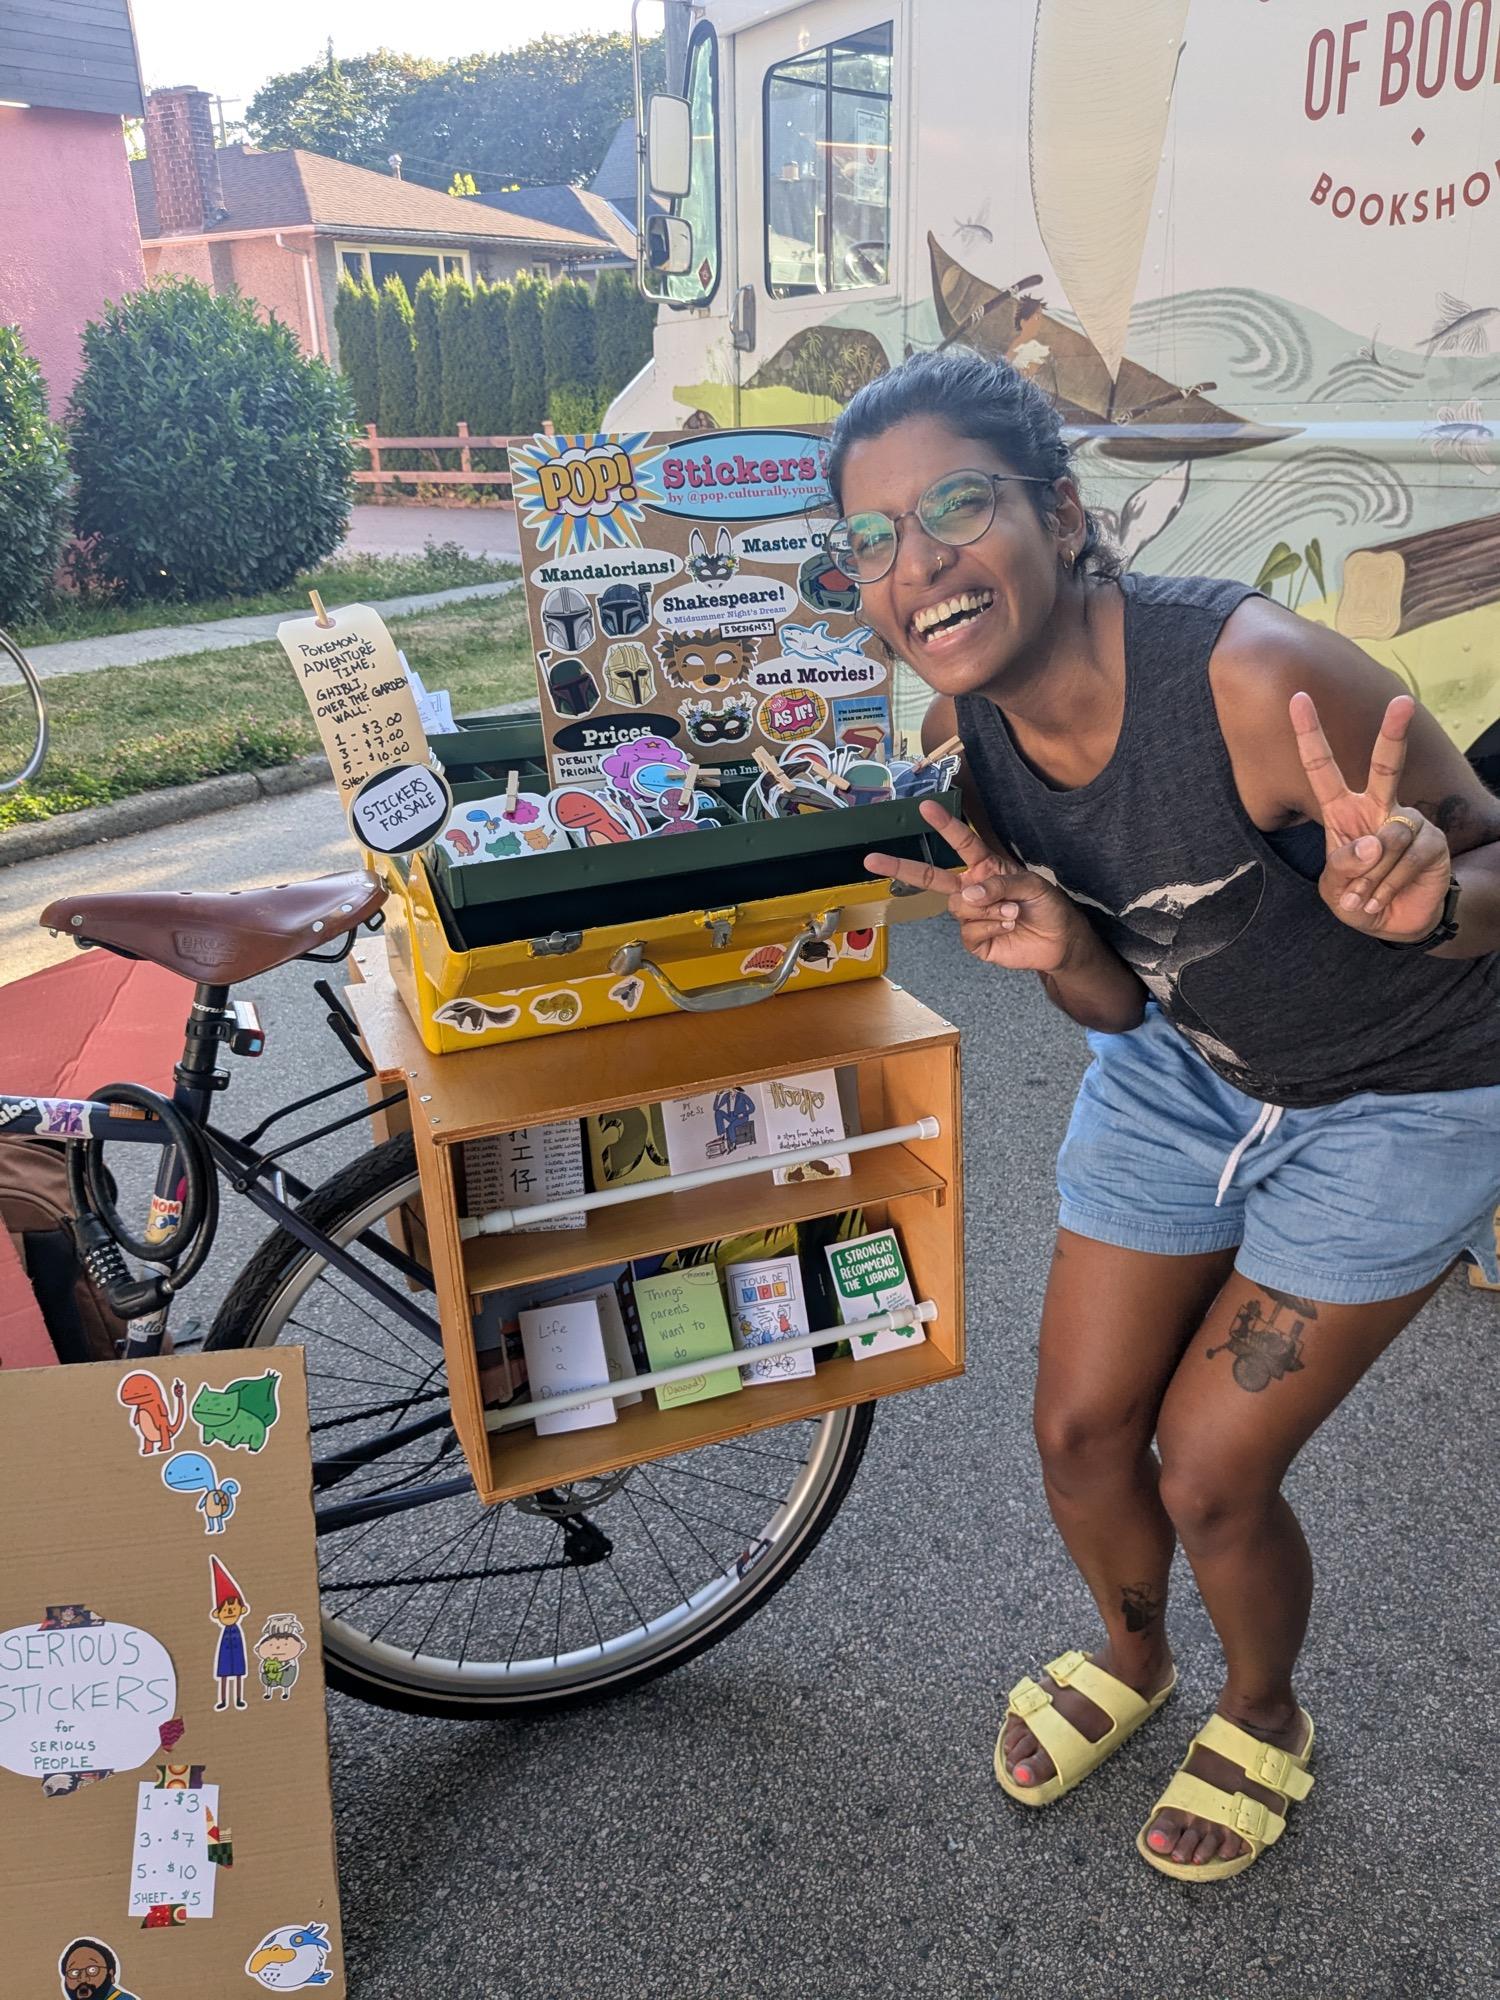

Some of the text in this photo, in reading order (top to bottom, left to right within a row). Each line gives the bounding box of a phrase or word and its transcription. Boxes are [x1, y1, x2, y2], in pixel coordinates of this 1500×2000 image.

[1304, 0, 1500, 121] OF BOO
[1310, 159, 1500, 226] BOOKSHO
[537, 453, 637, 511] POP!
[668, 492, 684, 506] by
[742, 535, 808, 554] Master
[540, 559, 675, 583] Mandalorians!
[663, 586, 784, 613] Shakespeare!
[665, 606, 787, 625] A Midsummer Night's Dream
[724, 623, 772, 634] 5 DESIGNS!
[298, 633, 364, 657] POKEMON,
[303, 641, 376, 678] ADVENTURE
[333, 658, 376, 679] TIME,
[755, 665, 876, 686] and Movies!
[316, 678, 368, 701] GHIBLI,
[317, 676, 409, 717] OVER THE GARDEN
[332, 704, 372, 724] WALL:
[774, 703, 814, 727] AS IF!
[334, 733, 346, 746] 1
[362, 712, 402, 734] $3.00
[582, 726, 653, 747] Prices
[339, 748, 349, 760] 3
[365, 728, 404, 749] $7.00
[343, 760, 352, 774] 5
[368, 741, 410, 762] $10.00
[557, 755, 593, 767] DEBUT
[723, 768, 738, 776] on
[362, 777, 428, 822] STICKERS
[380, 791, 437, 831] FOR SALE
[836, 1240, 892, 1266] I STRONGLY
[840, 1254, 895, 1279] RECOMMEND
[740, 1271, 783, 1287] TOUR DE
[843, 1267, 899, 1293] THE LIBRARY
[644, 1286, 684, 1303] Things
[743, 1282, 787, 1302] VPL
[650, 1303, 689, 1324] parents
[539, 1320, 568, 1339] Life
[692, 1320, 705, 1331] to
[674, 1346, 687, 1359] do
[0, 1631, 140, 1670] SERIOUS
[0, 1675, 169, 1722] STICKERS
[55, 1719, 75, 1733] for
[30, 1740, 96, 1753] SERIOUS
[34, 1755, 93, 1770] PEOPLE
[142, 1794, 151, 1810] 1
[174, 1791, 200, 1813] $3
[140, 1832, 151, 1848] 3
[171, 1829, 195, 1848] $7
[136, 1863, 147, 1879] 5
[167, 1860, 197, 1879] $10
[133, 1891, 168, 1905] SHEET
[181, 1889, 201, 1906] $5
